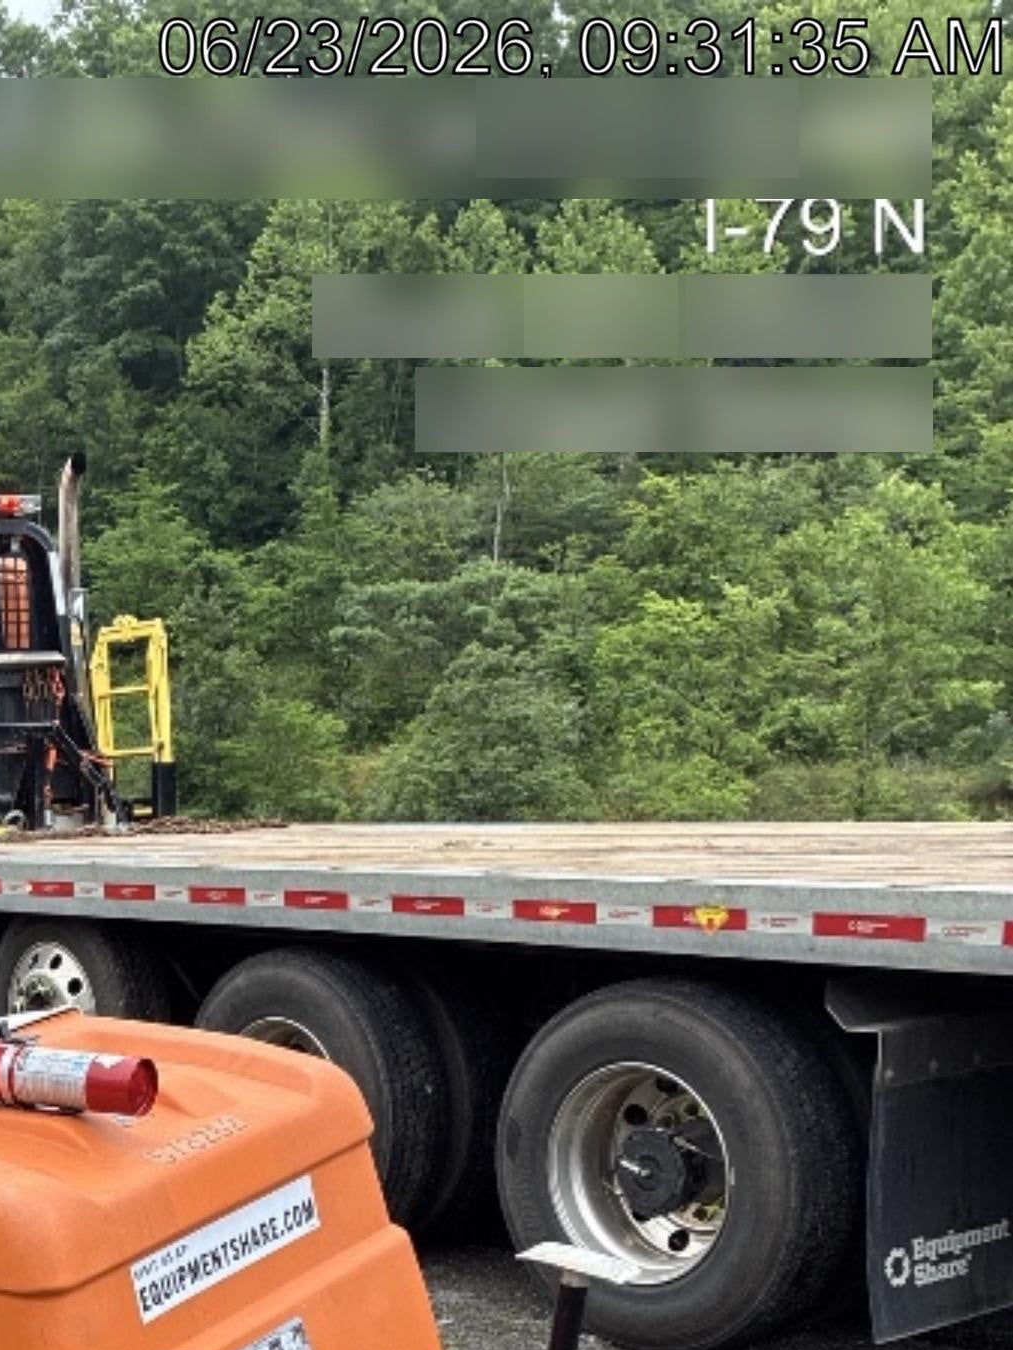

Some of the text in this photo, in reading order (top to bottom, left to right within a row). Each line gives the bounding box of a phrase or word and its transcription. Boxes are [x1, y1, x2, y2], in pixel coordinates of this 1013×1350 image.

[139, 1197, 315, 1312] EQUIPMENTSHARE.COM
[911, 1217, 1011, 1260] Equipment
[913, 1259, 969, 1287] Share
